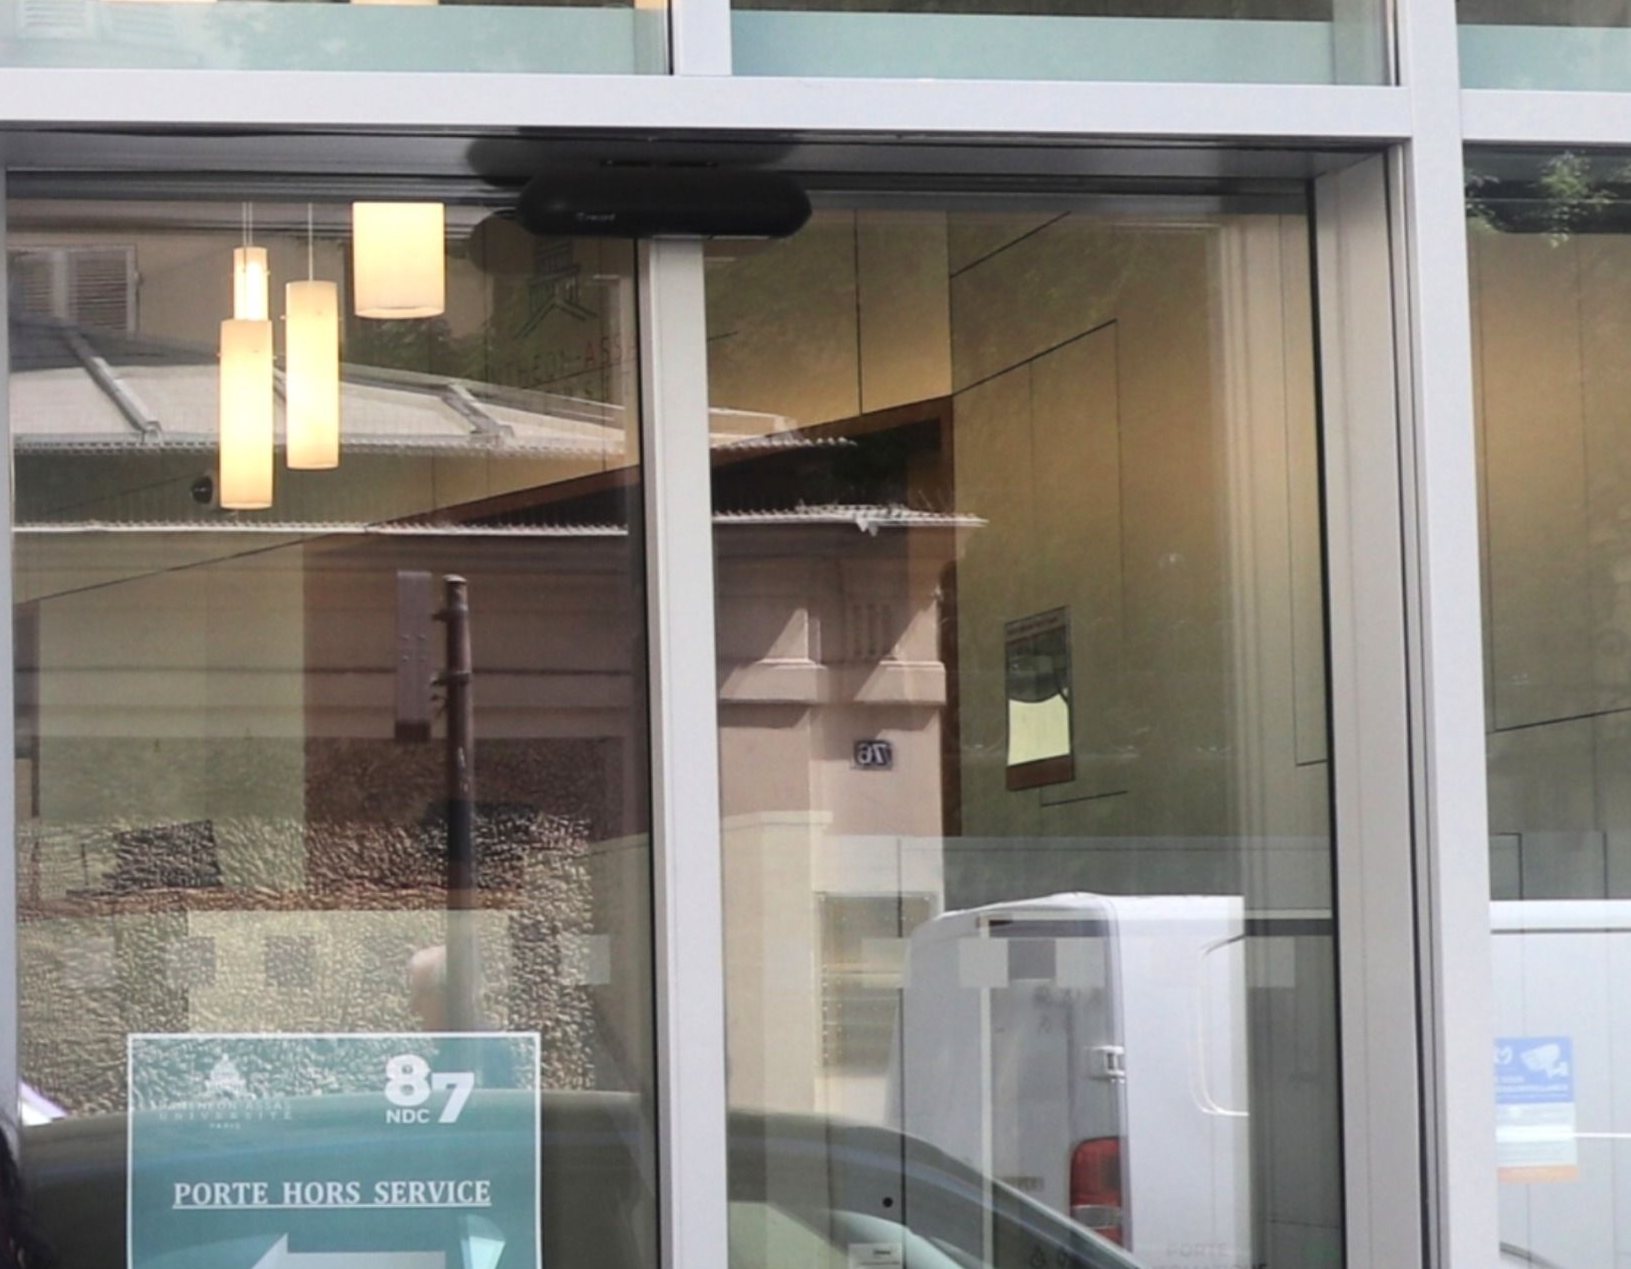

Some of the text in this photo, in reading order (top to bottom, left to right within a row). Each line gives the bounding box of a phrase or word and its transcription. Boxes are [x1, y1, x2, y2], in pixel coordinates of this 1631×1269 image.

[384, 1053, 475, 1124] 87
[385, 1108, 430, 1124] NDC
[174, 1179, 492, 1206] PORTE HORS SERVICE
